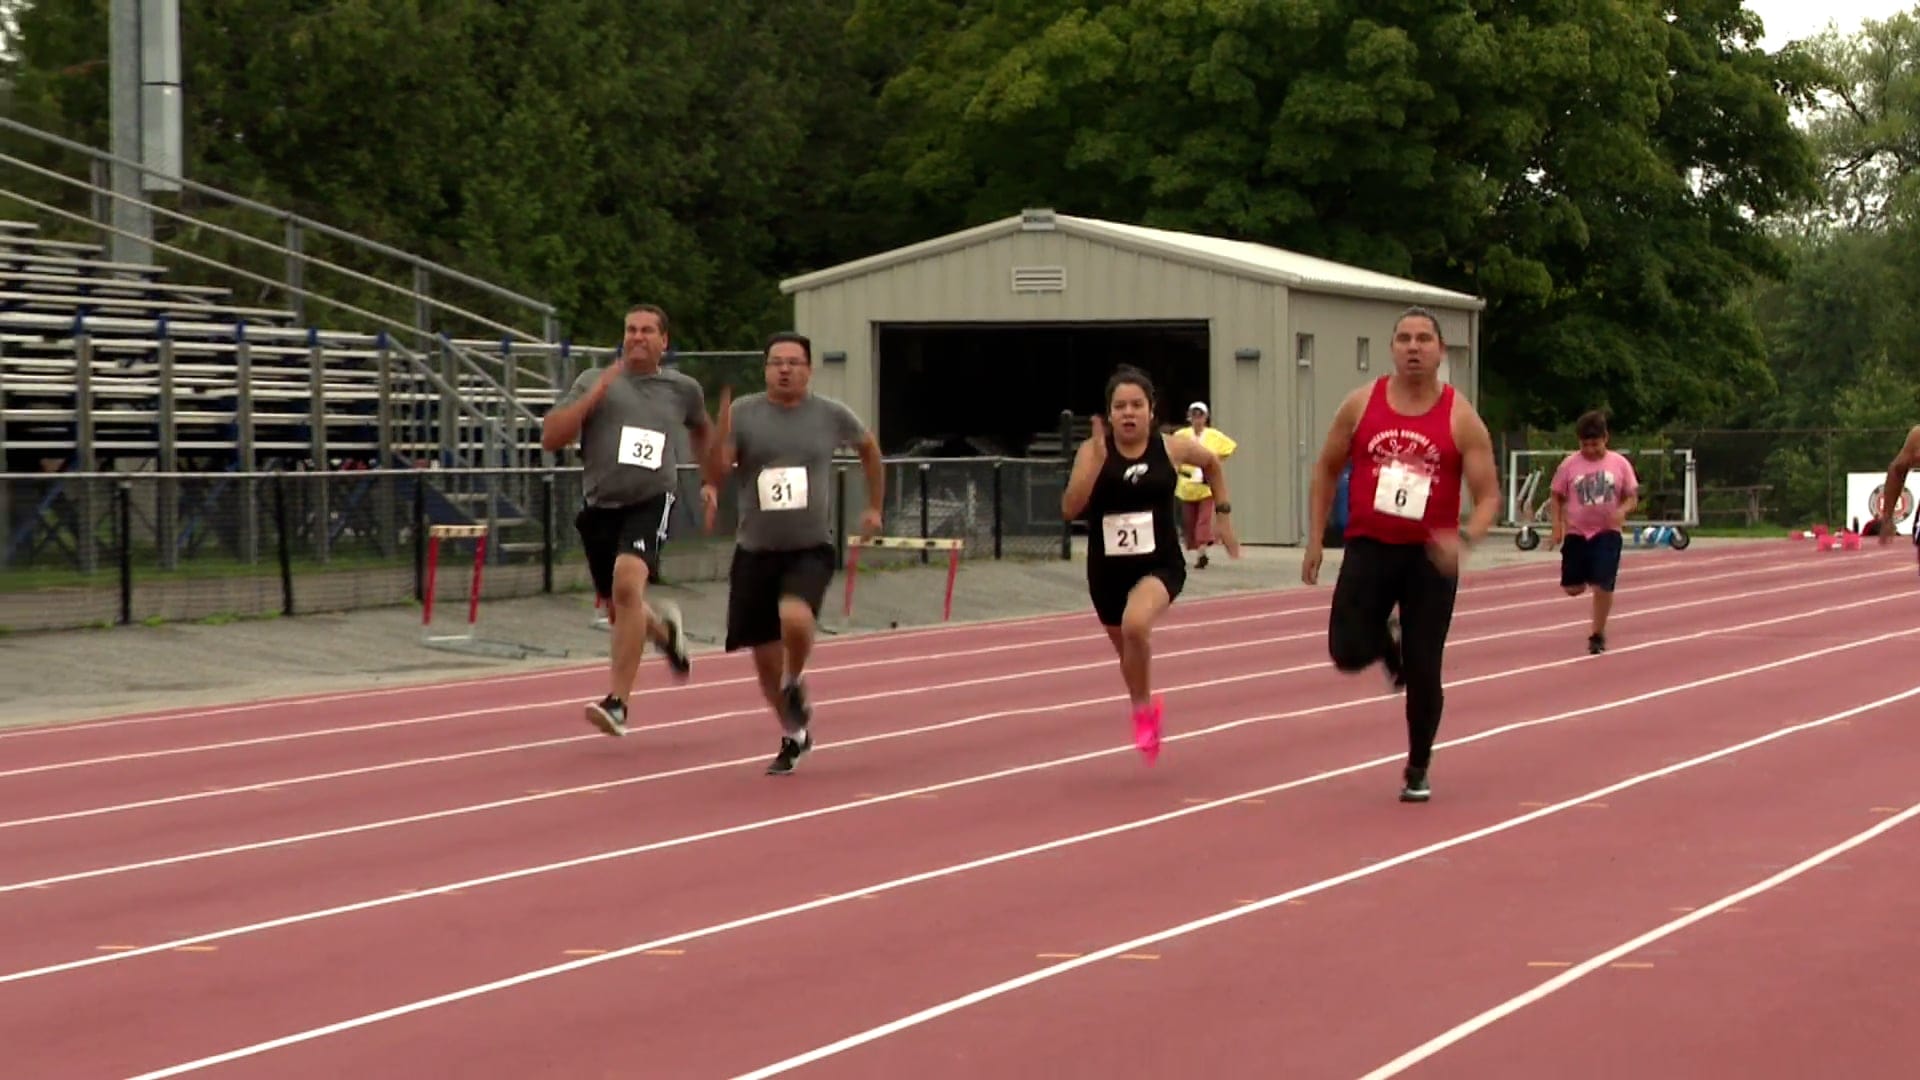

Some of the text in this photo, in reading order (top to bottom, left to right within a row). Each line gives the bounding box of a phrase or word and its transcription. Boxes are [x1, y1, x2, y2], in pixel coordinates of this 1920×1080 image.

[632, 442, 654, 461] 32
[771, 483, 792, 502] 31
[1395, 488, 1408, 507] 6
[1117, 529, 1138, 547] 21
